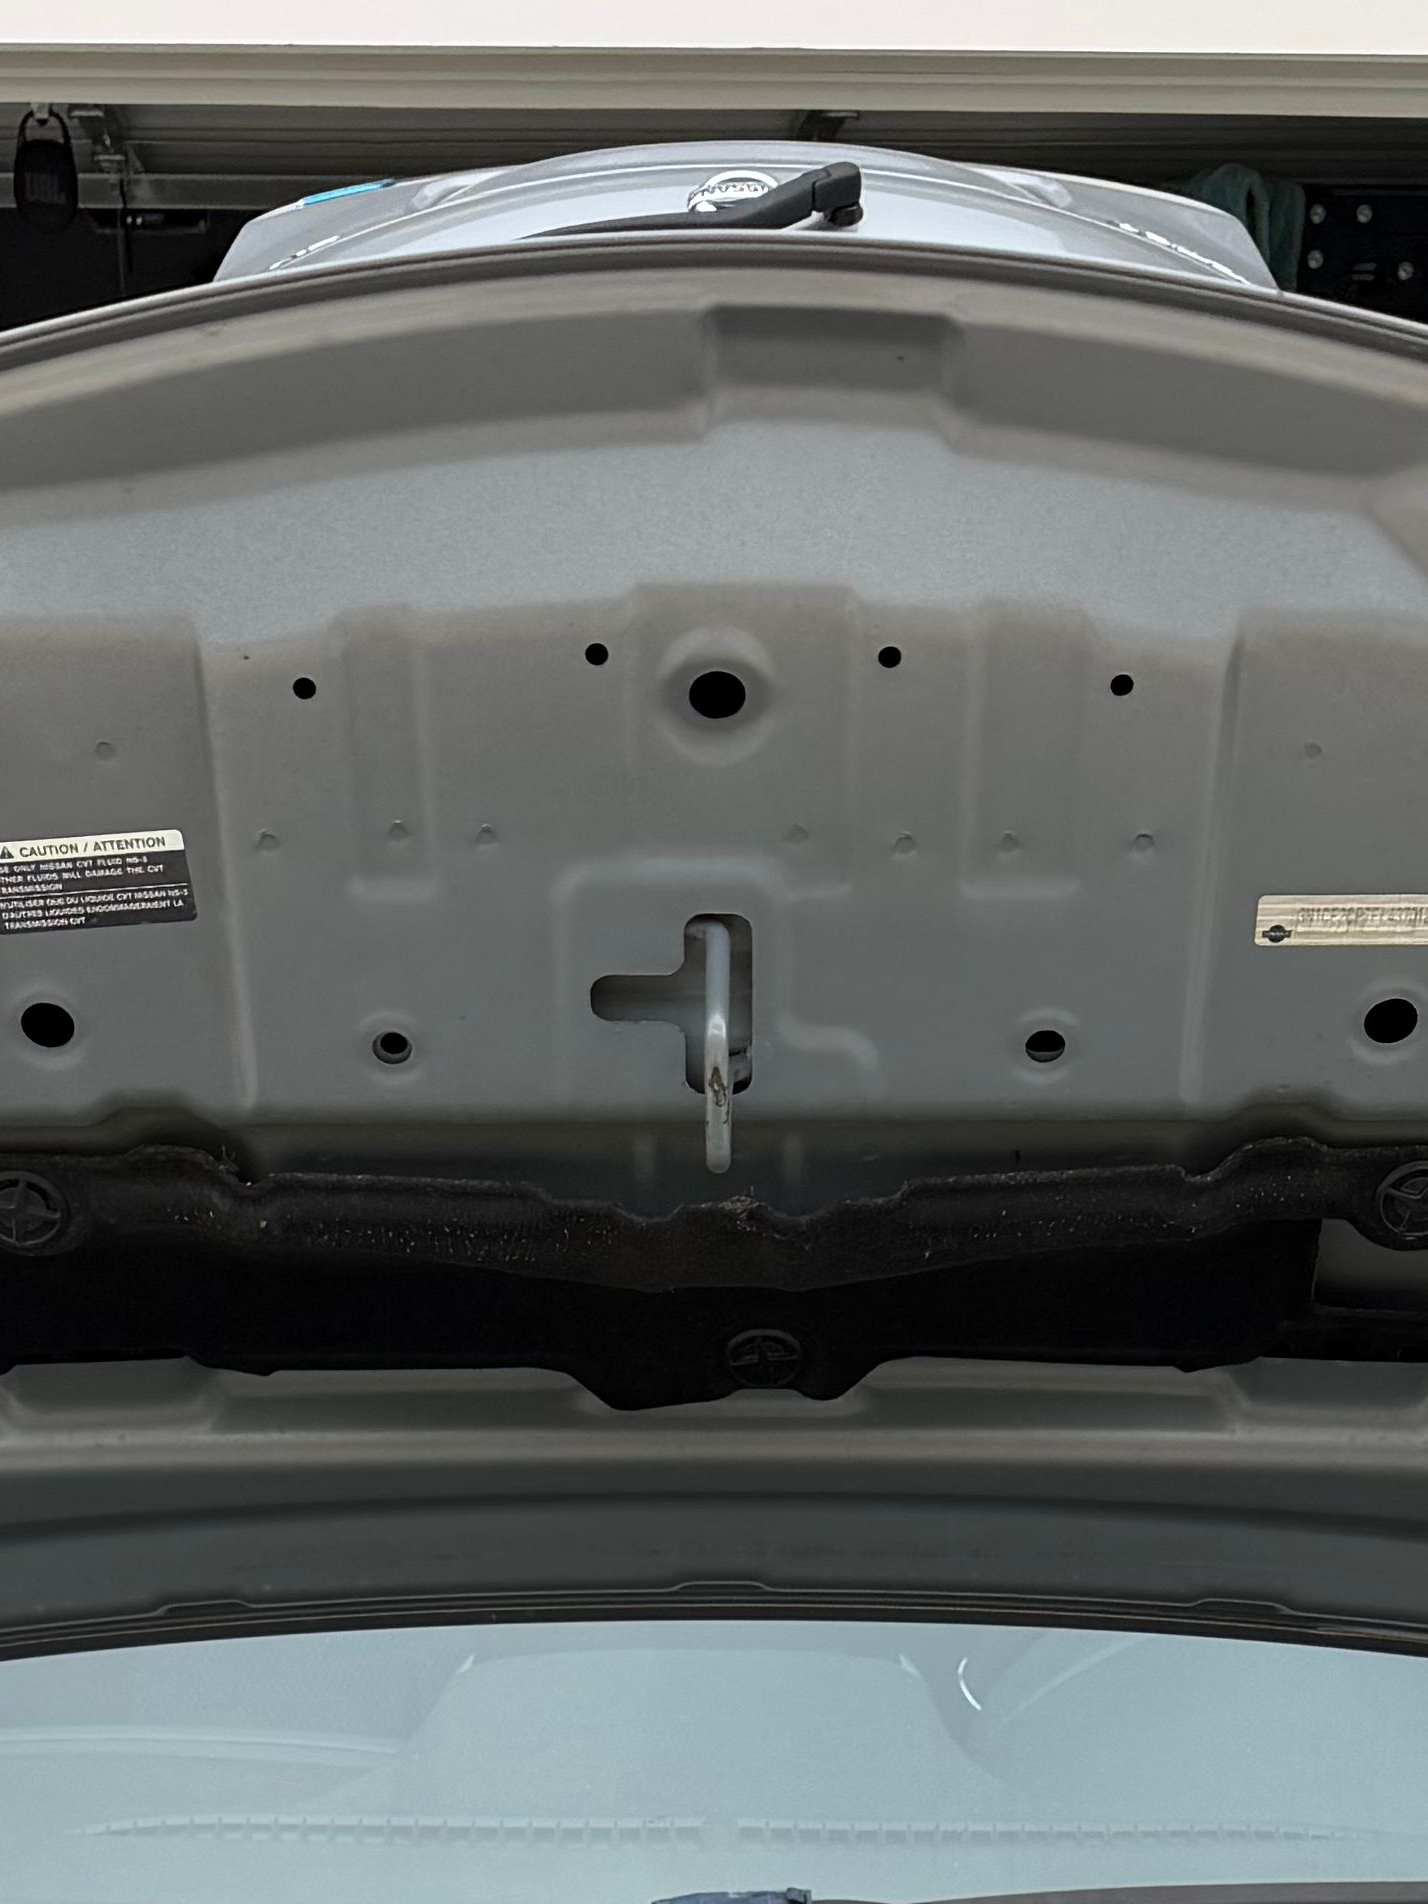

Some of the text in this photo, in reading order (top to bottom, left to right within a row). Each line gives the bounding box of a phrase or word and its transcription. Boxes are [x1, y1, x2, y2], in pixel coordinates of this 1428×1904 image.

[20, 844, 78, 858] CAUTION
[93, 836, 166, 852] ATTENTION
[40, 862, 72, 871] NISSAN
[76, 860, 92, 868] CVT
[97, 858, 122, 866] FLUID
[27, 874, 58, 883] FLUIDS
[85, 868, 122, 877] DAMAGE
[127, 866, 144, 874] THE
[147, 864, 164, 873] CVT
[117, 893, 132, 901] CVT
[134, 891, 166, 900] NISSAN
[4, 917, 86, 930] TRANSMISSION CVT
